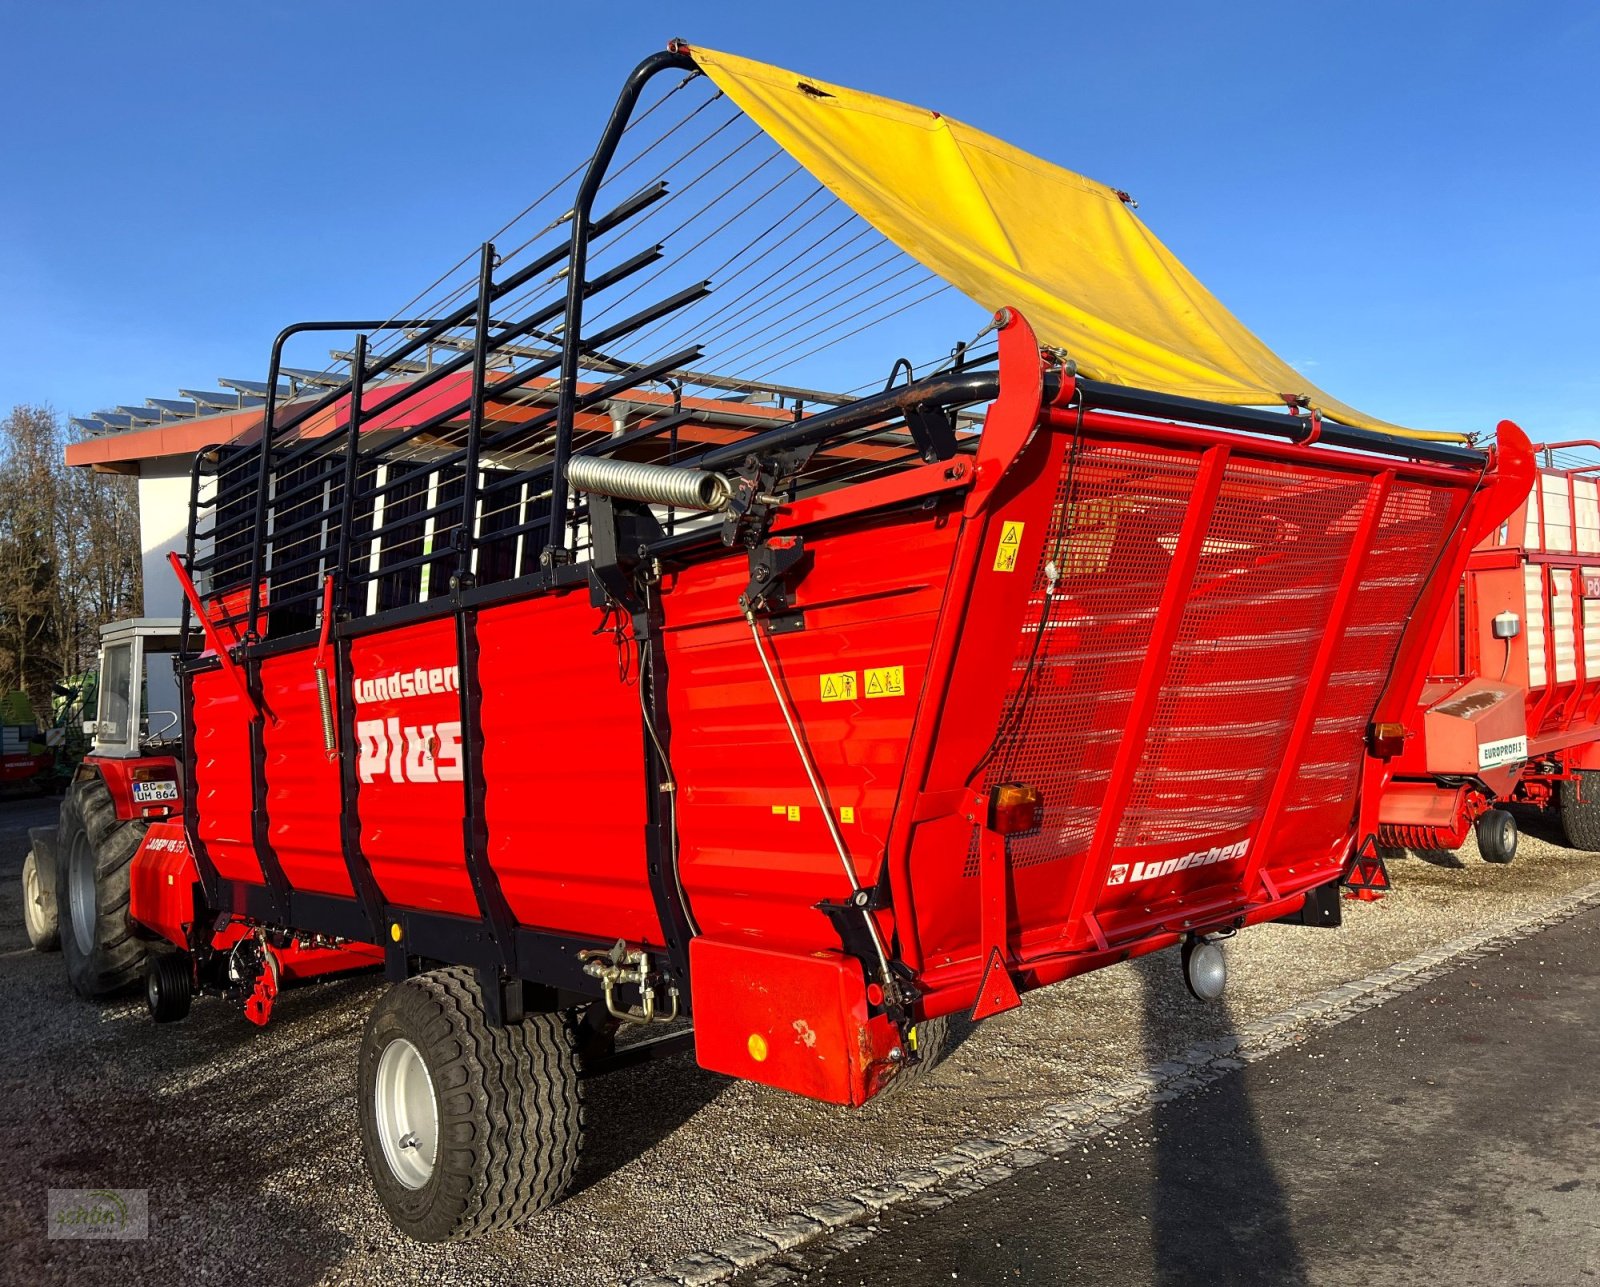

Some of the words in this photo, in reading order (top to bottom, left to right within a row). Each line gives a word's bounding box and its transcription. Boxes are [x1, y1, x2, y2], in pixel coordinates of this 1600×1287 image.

[142, 783, 156, 791] BC
[137, 792, 152, 801] UM
[155, 790, 176, 799] 864
[1129, 837, 1251, 883] Landsberg
